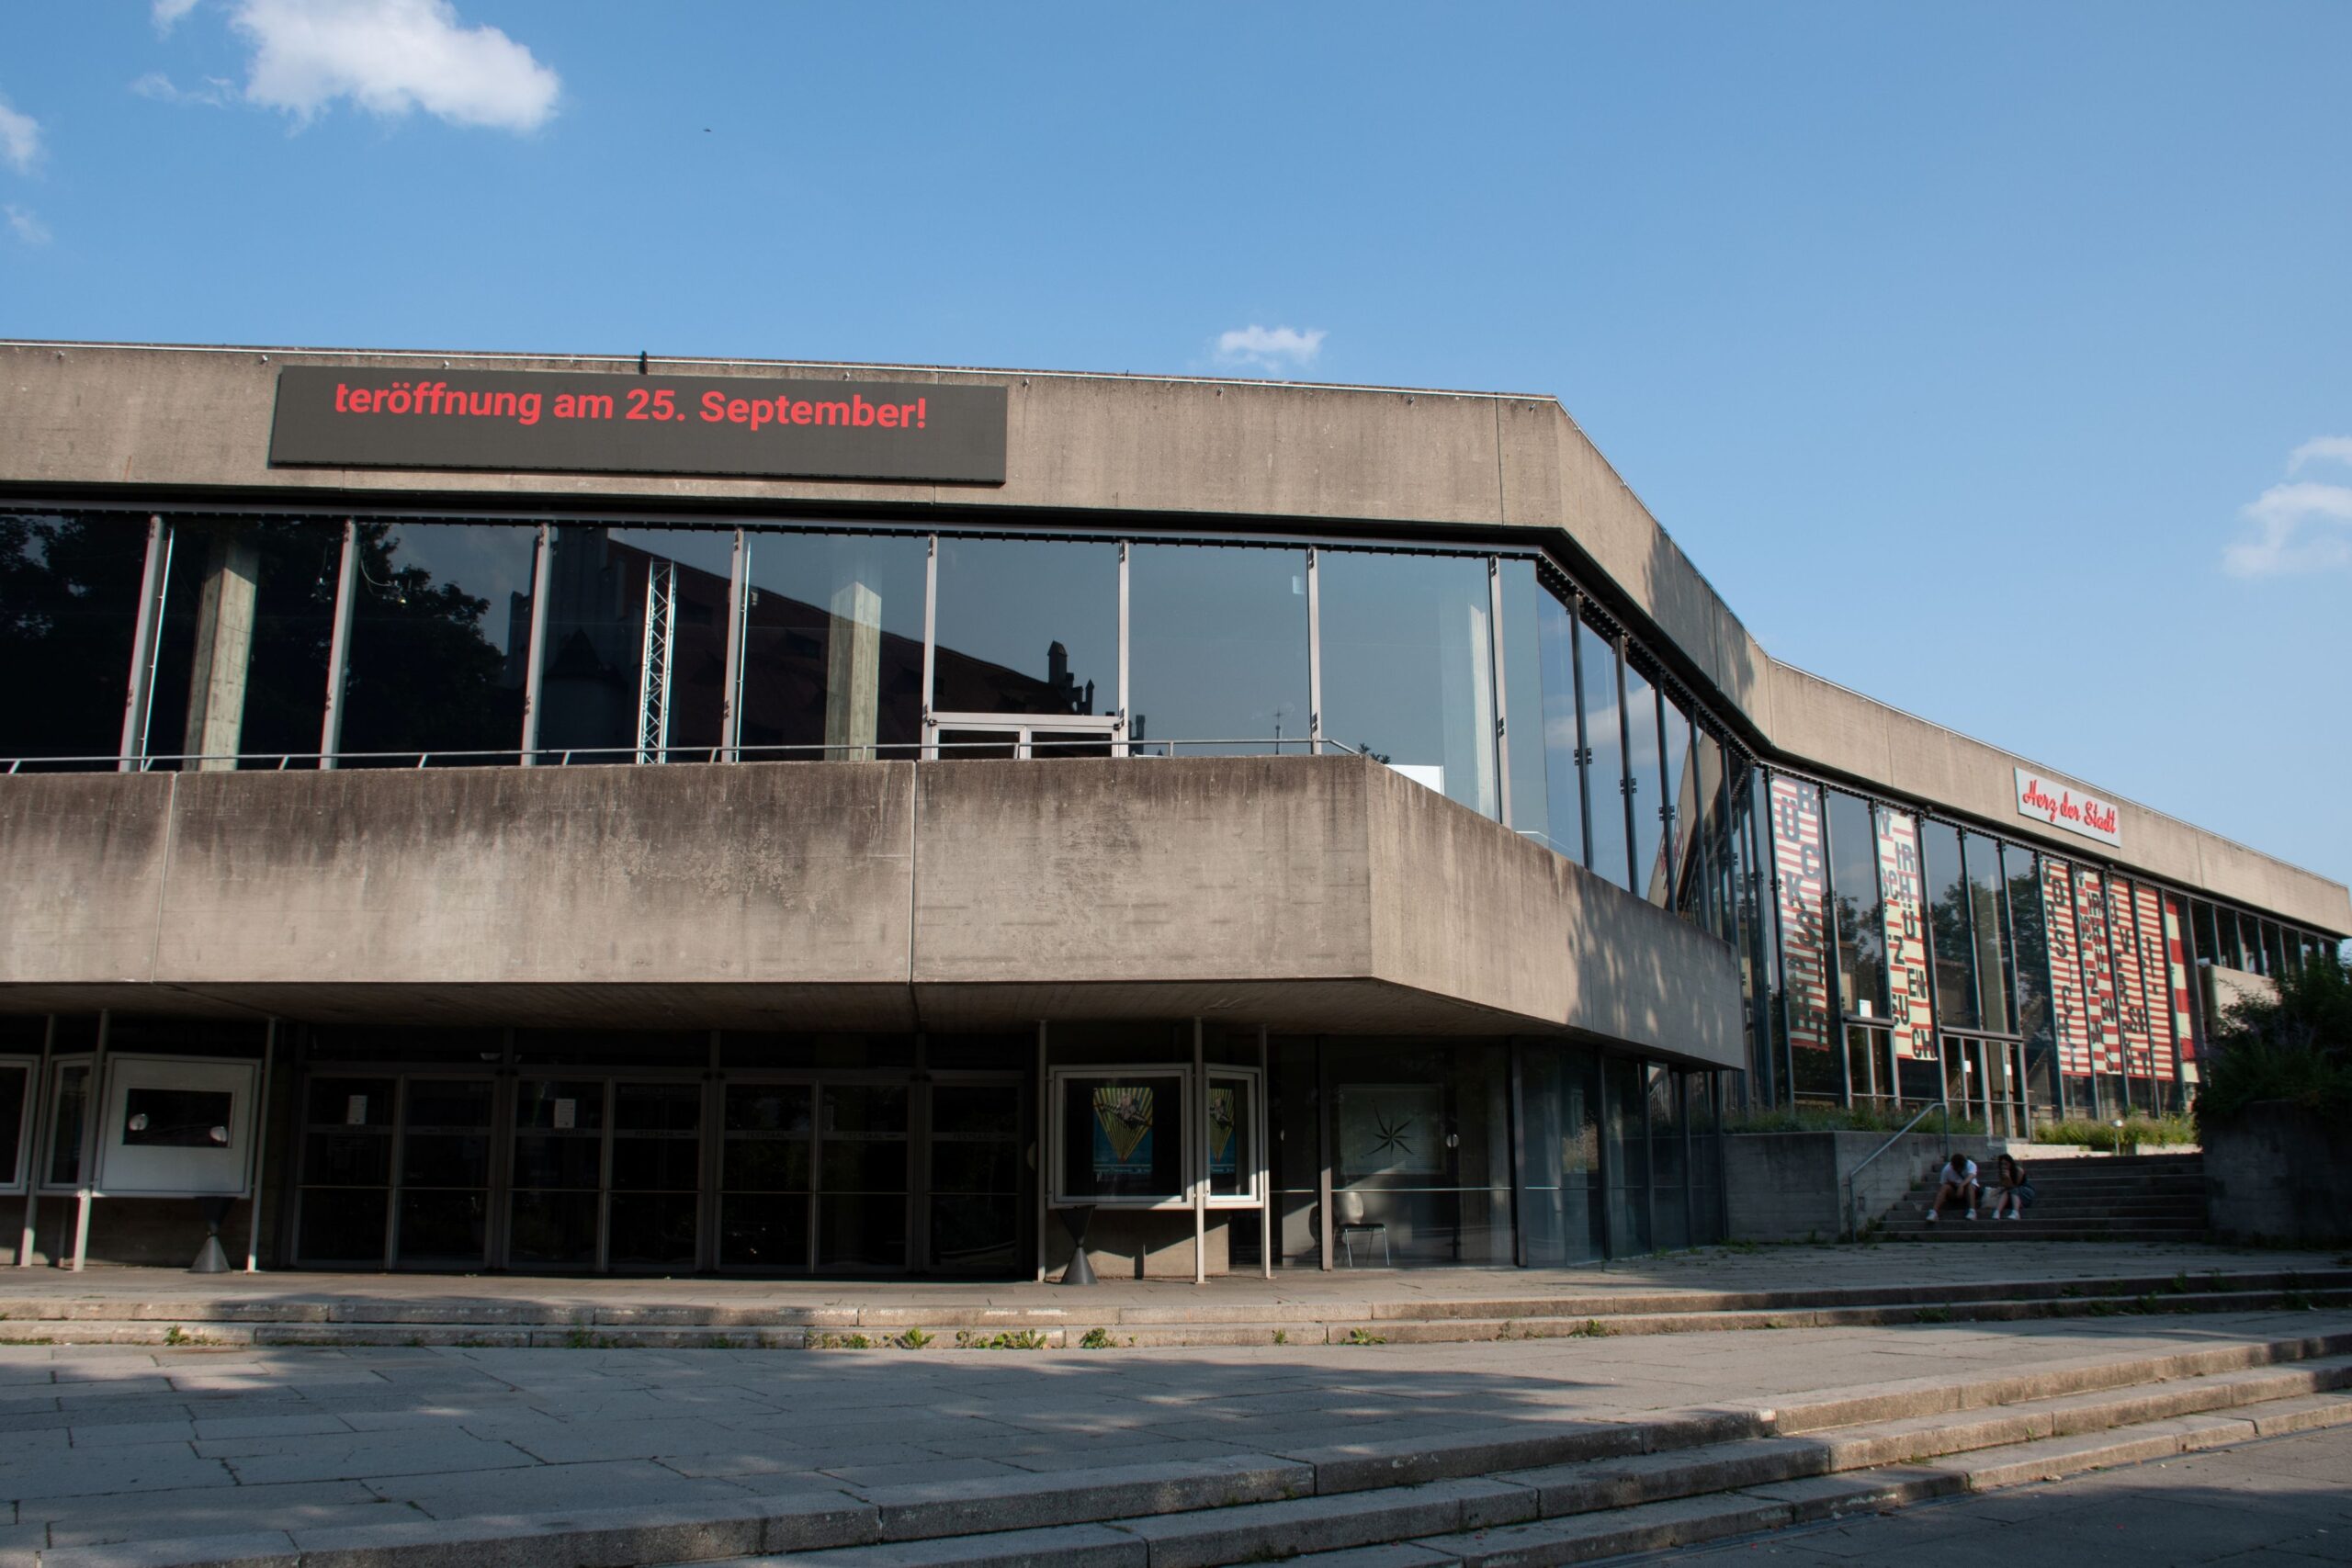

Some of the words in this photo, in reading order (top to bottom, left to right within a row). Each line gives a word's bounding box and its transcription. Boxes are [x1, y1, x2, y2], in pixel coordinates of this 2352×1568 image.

[335, 382, 542, 425] teröffnung
[553, 393, 614, 419] am
[626, 389, 685, 422] 25.
[699, 390, 926, 431] September!
[2023, 779, 2058, 822] Herz
[2060, 791, 2081, 821] der
[2084, 801, 2117, 834] Stadt
